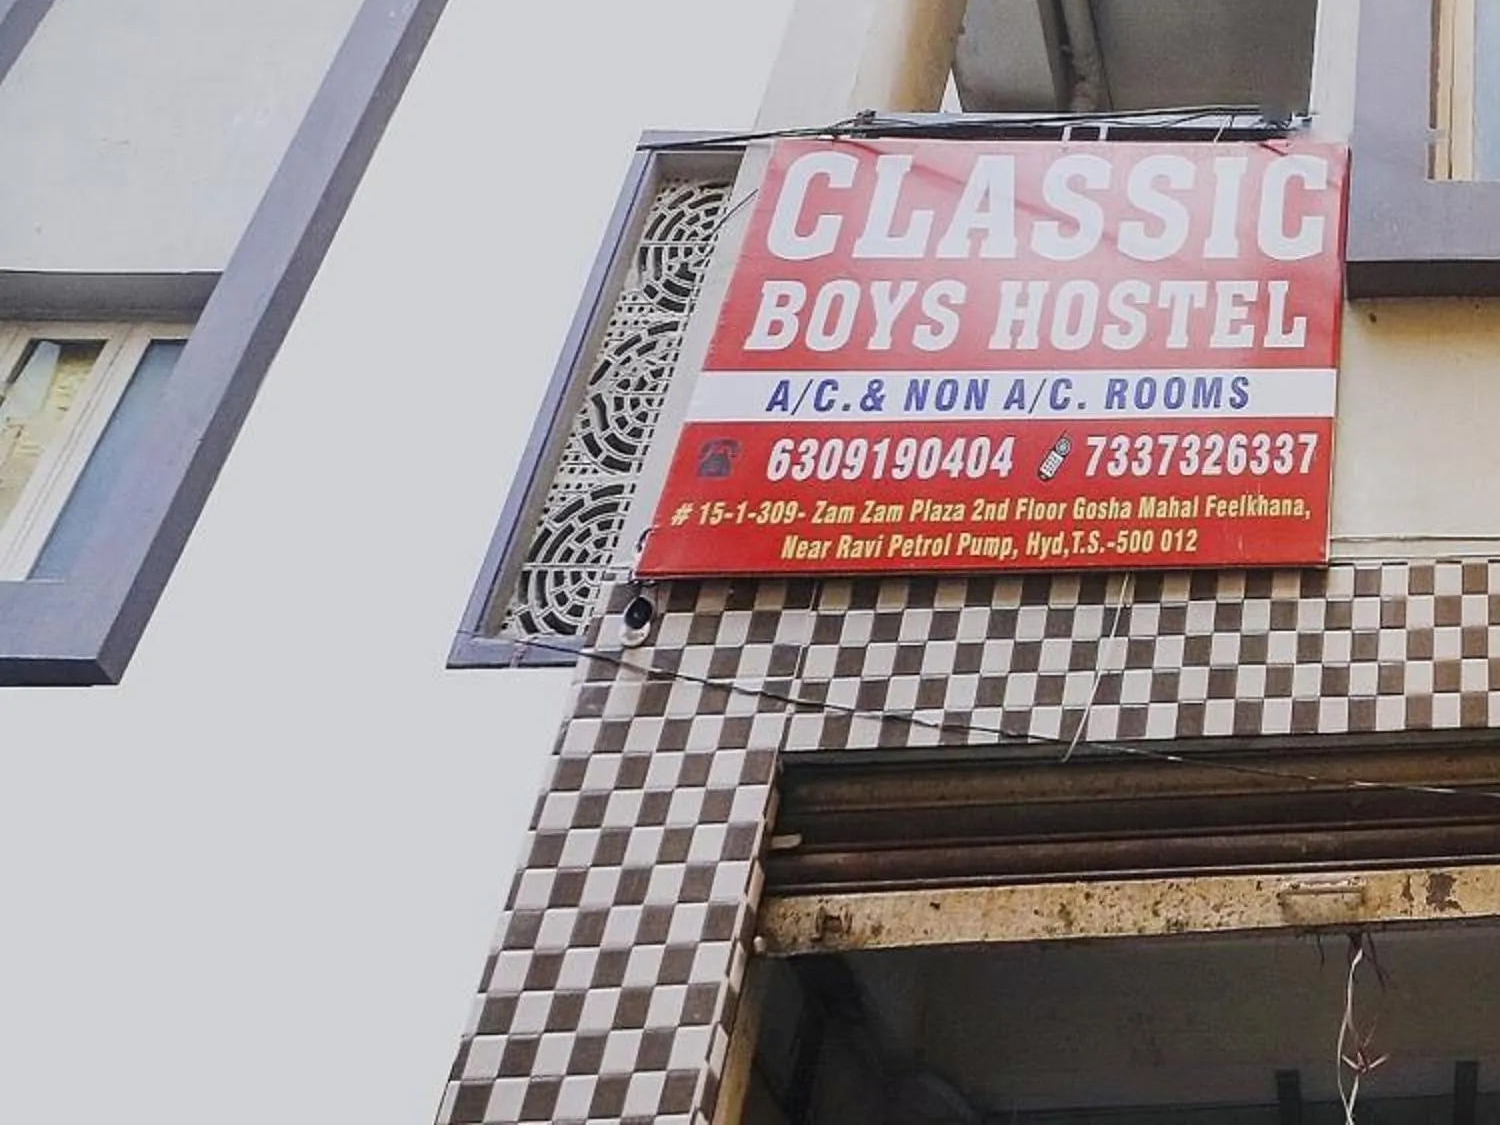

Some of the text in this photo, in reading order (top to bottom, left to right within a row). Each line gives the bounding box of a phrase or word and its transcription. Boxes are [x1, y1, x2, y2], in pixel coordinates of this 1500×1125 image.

[767, 150, 1328, 261] CLASSIC
[743, 279, 1307, 352] BOYS HOSTEL
[904, 378, 989, 412] NON
[1003, 378, 1086, 414] A/C.
[1104, 376, 1250, 410] ROOMS
[766, 433, 1318, 481] 6309190404 7337326337
[671, 493, 1311, 525] # 15-1-309- Zam Zam Plaza 2nd Floor Gosha Mahal Feelkhana,
[780, 535, 831, 560] Near
[836, 534, 883, 559] Ravi
[887, 532, 952, 559] Petrol
[957, 531, 1018, 560] Pump,
[1160, 528, 1198, 552] 012
